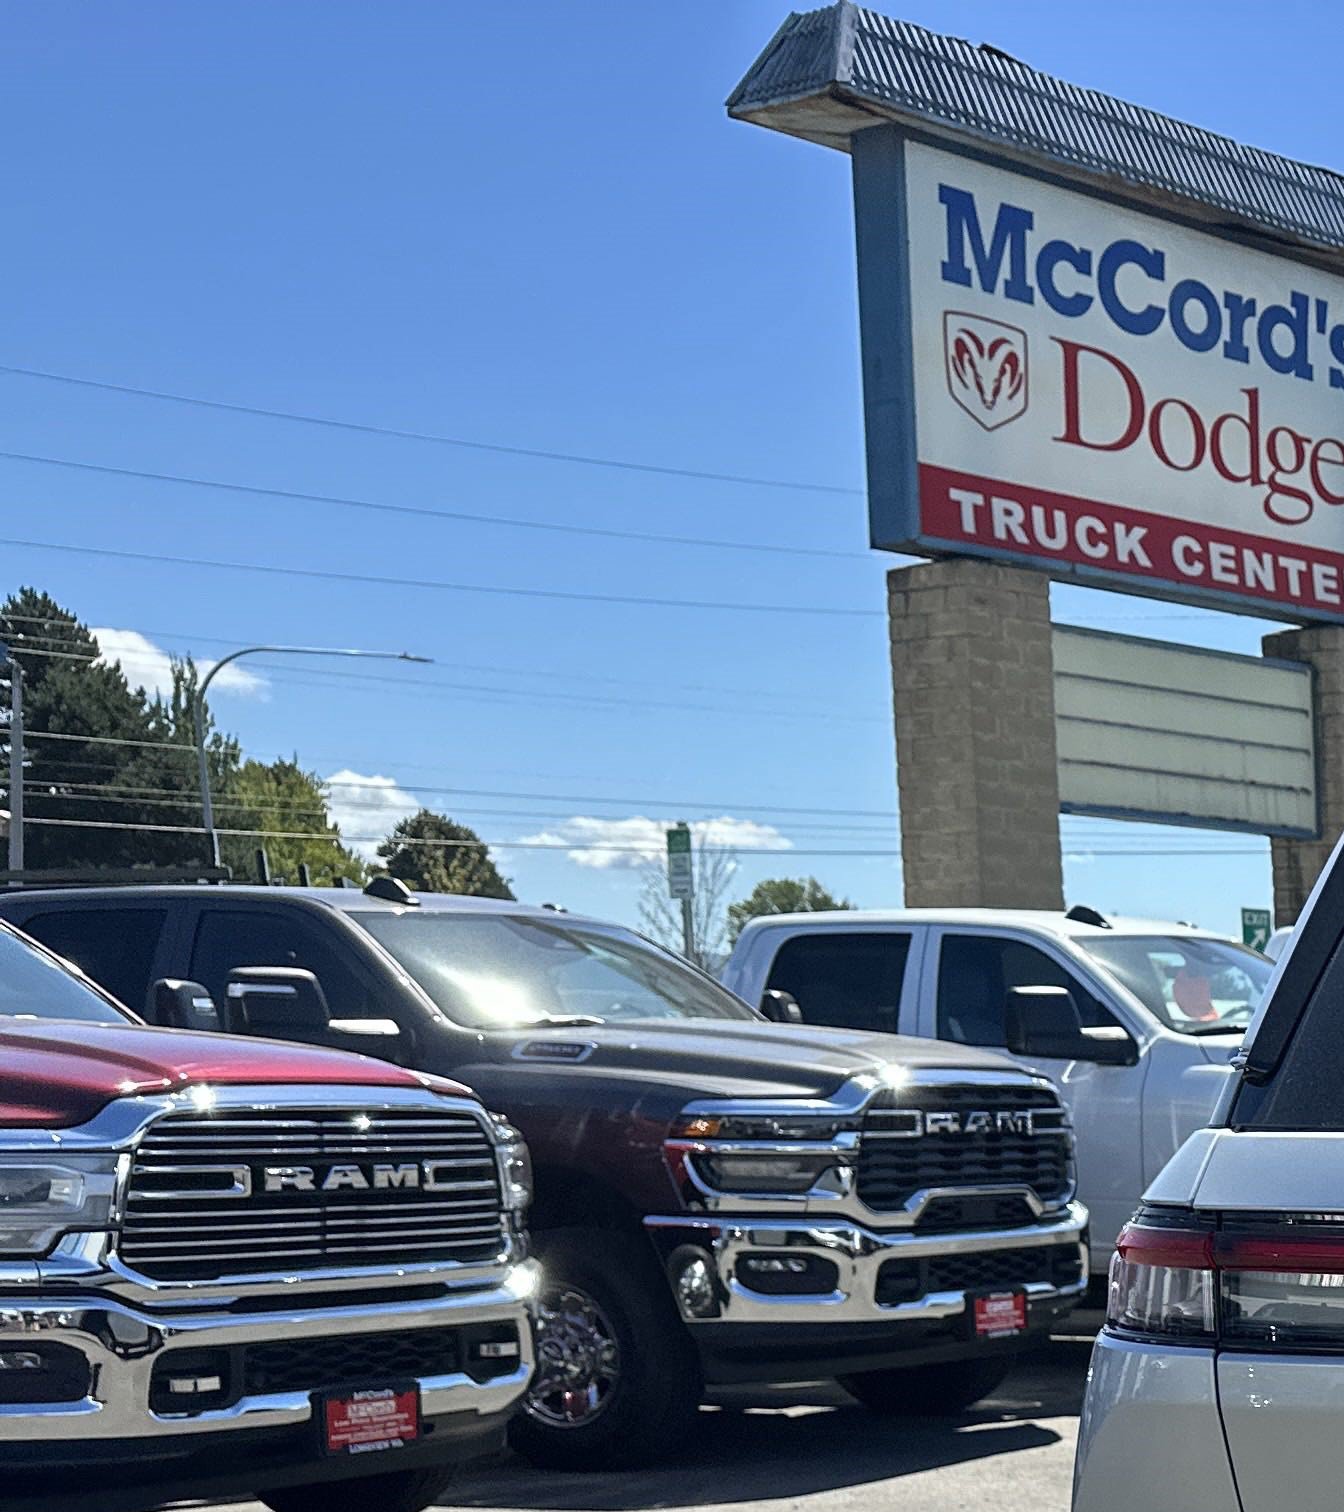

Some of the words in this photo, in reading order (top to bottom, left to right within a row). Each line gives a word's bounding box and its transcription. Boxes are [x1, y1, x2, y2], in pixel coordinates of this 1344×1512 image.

[948, 487, 1152, 570] TRUCK
[925, 1111, 1031, 1133] RAM
[264, 1163, 419, 1192] RAM
